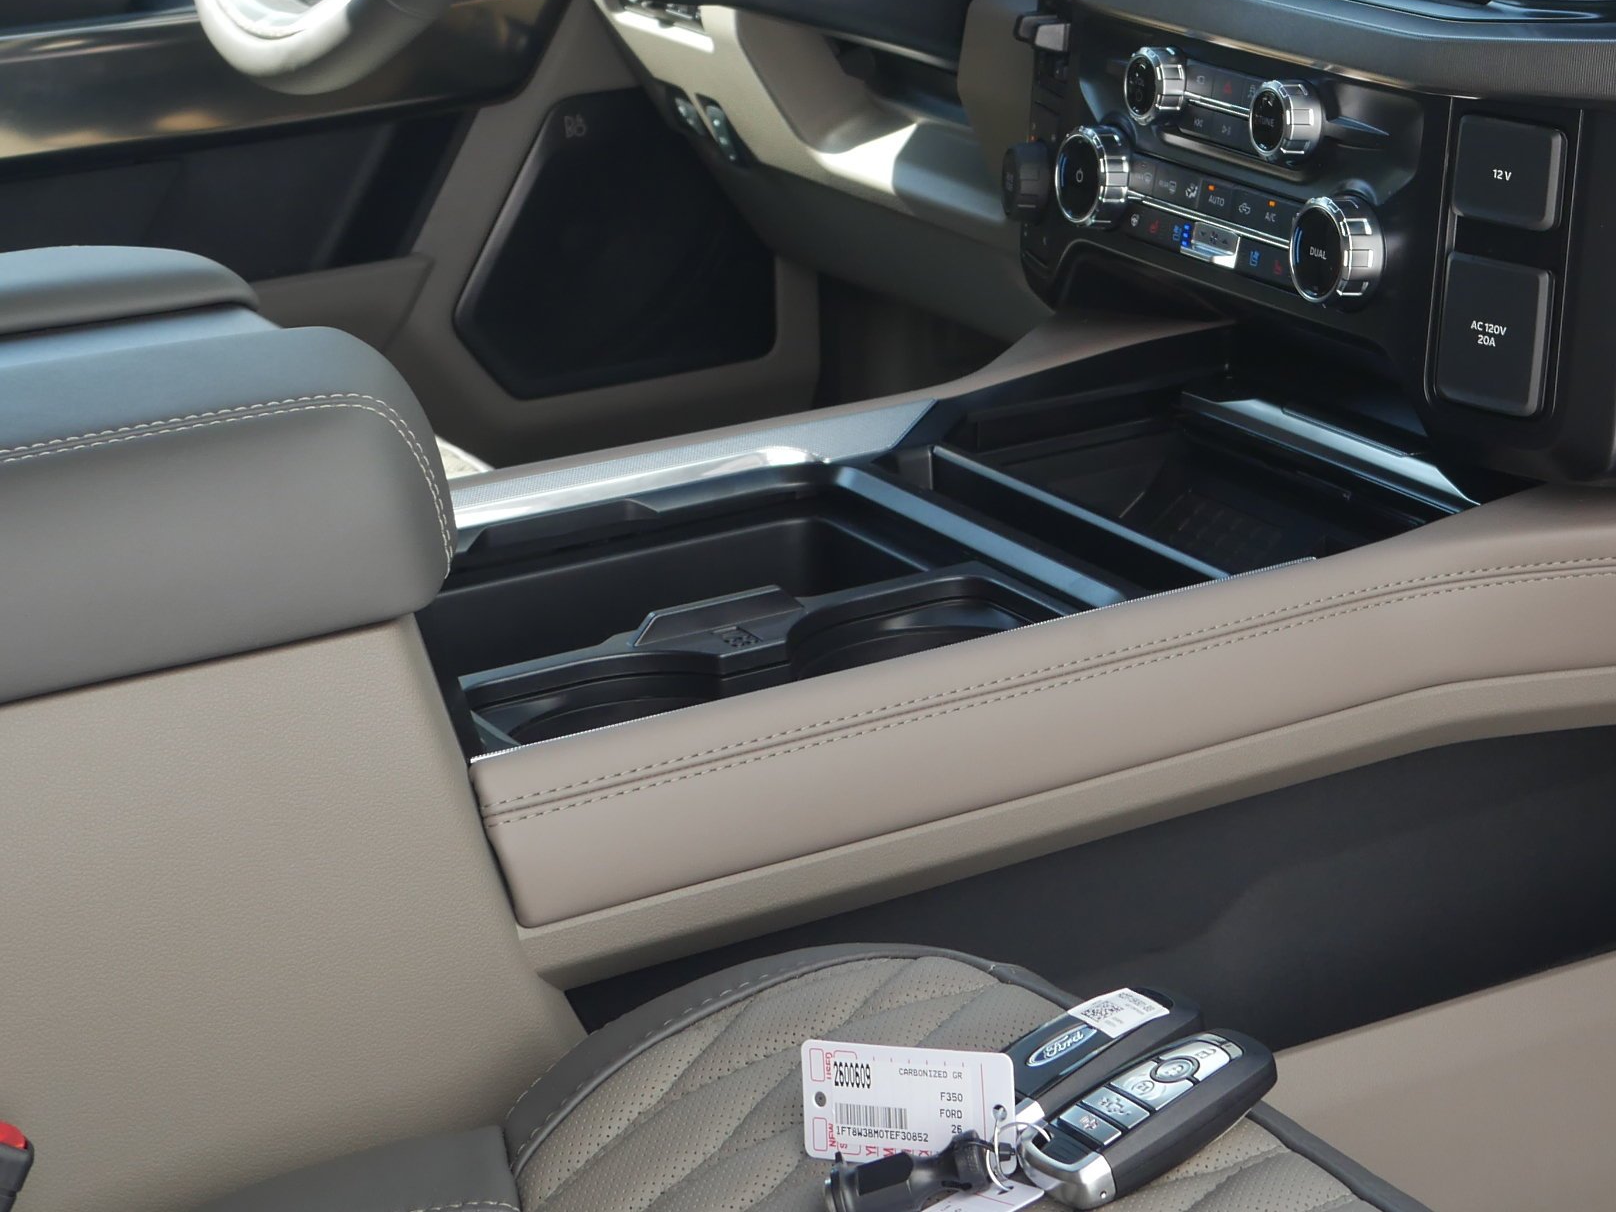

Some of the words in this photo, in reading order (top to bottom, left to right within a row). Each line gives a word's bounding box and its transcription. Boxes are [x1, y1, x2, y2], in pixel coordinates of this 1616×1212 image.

[1492, 169, 1503, 180] 12
[1504, 171, 1512, 181] V
[1208, 195, 1225, 207] AUTO
[1264, 211, 1277, 223] A/C
[1309, 245, 1328, 261] DUAL
[1470, 320, 1483, 332] AC
[1484, 323, 1507, 336] 120V
[1477, 334, 1496, 347] 20A
[1043, 1028, 1085, 1059] Ford
[833, 1060, 871, 1089] 2600609
[898, 1067, 948, 1079] CARBONIZED
[952, 1071, 963, 1080] GR
[940, 1091, 963, 1103] F350
[939, 1108, 963, 1119] FORD
[951, 1124, 963, 1134] 26
